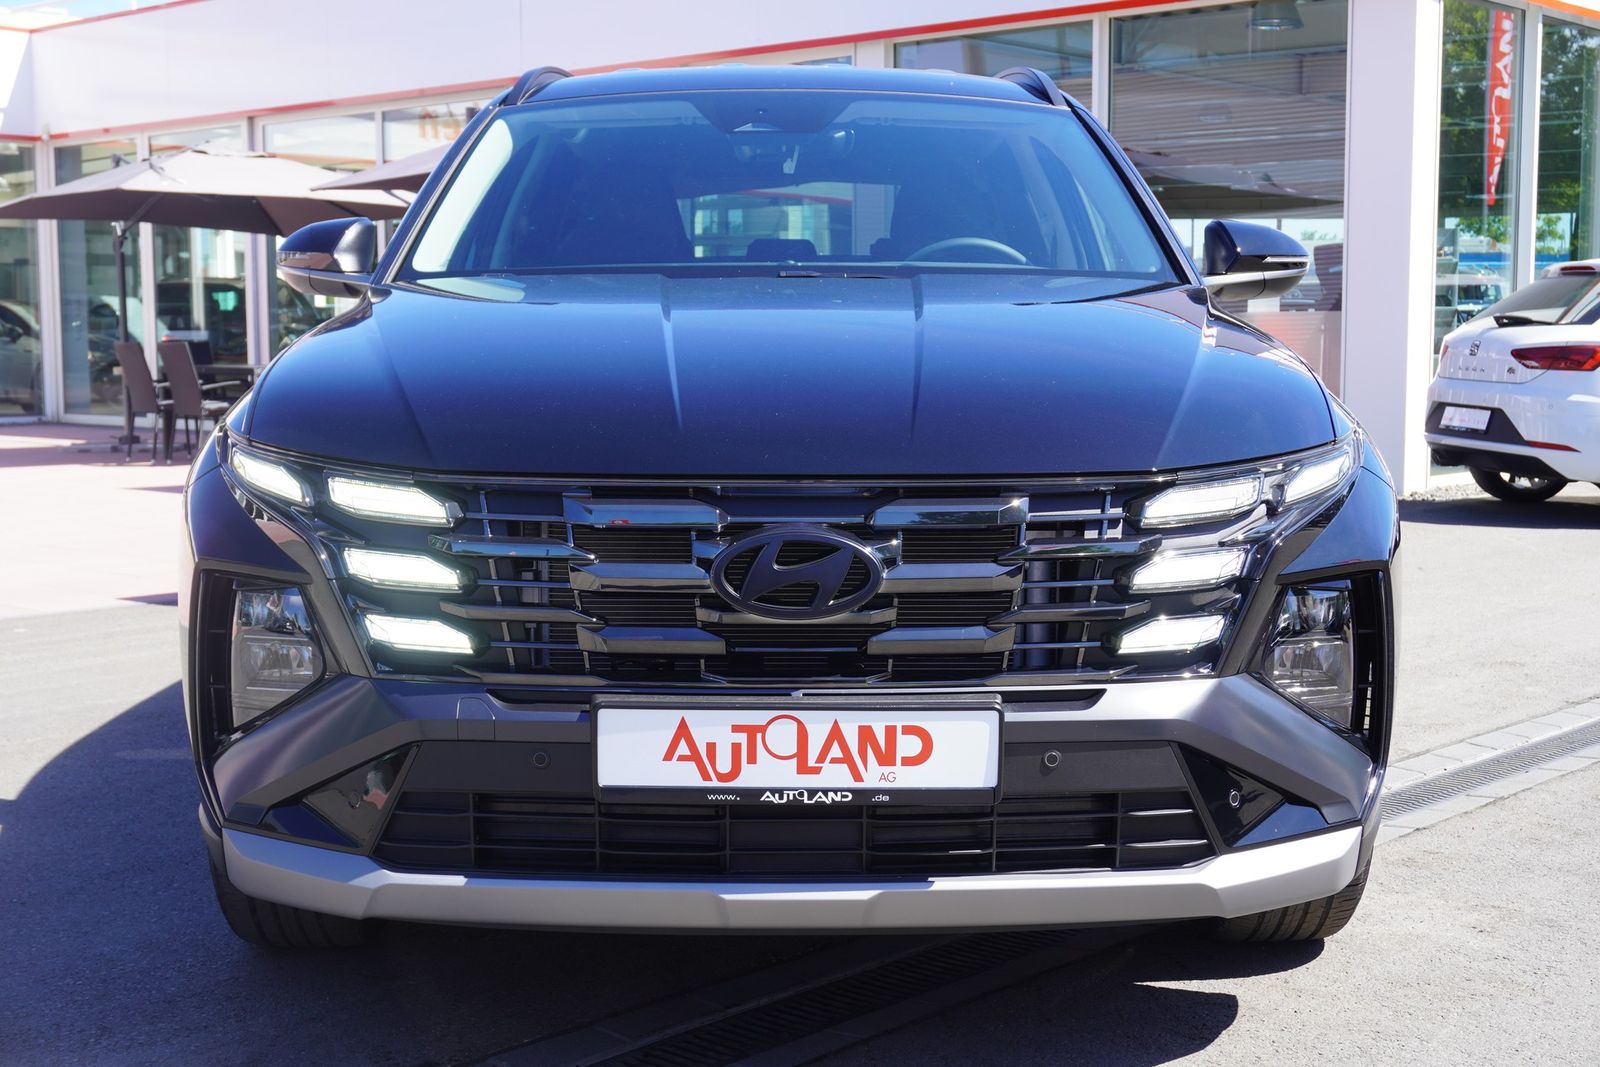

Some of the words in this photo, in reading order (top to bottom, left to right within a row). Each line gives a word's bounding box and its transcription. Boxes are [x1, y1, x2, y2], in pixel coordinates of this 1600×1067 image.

[662, 714, 934, 783] AUTOLAND
[878, 772, 897, 783] AG
[760, 789, 853, 804] AUTOLAND
[871, 793, 890, 802] .de
